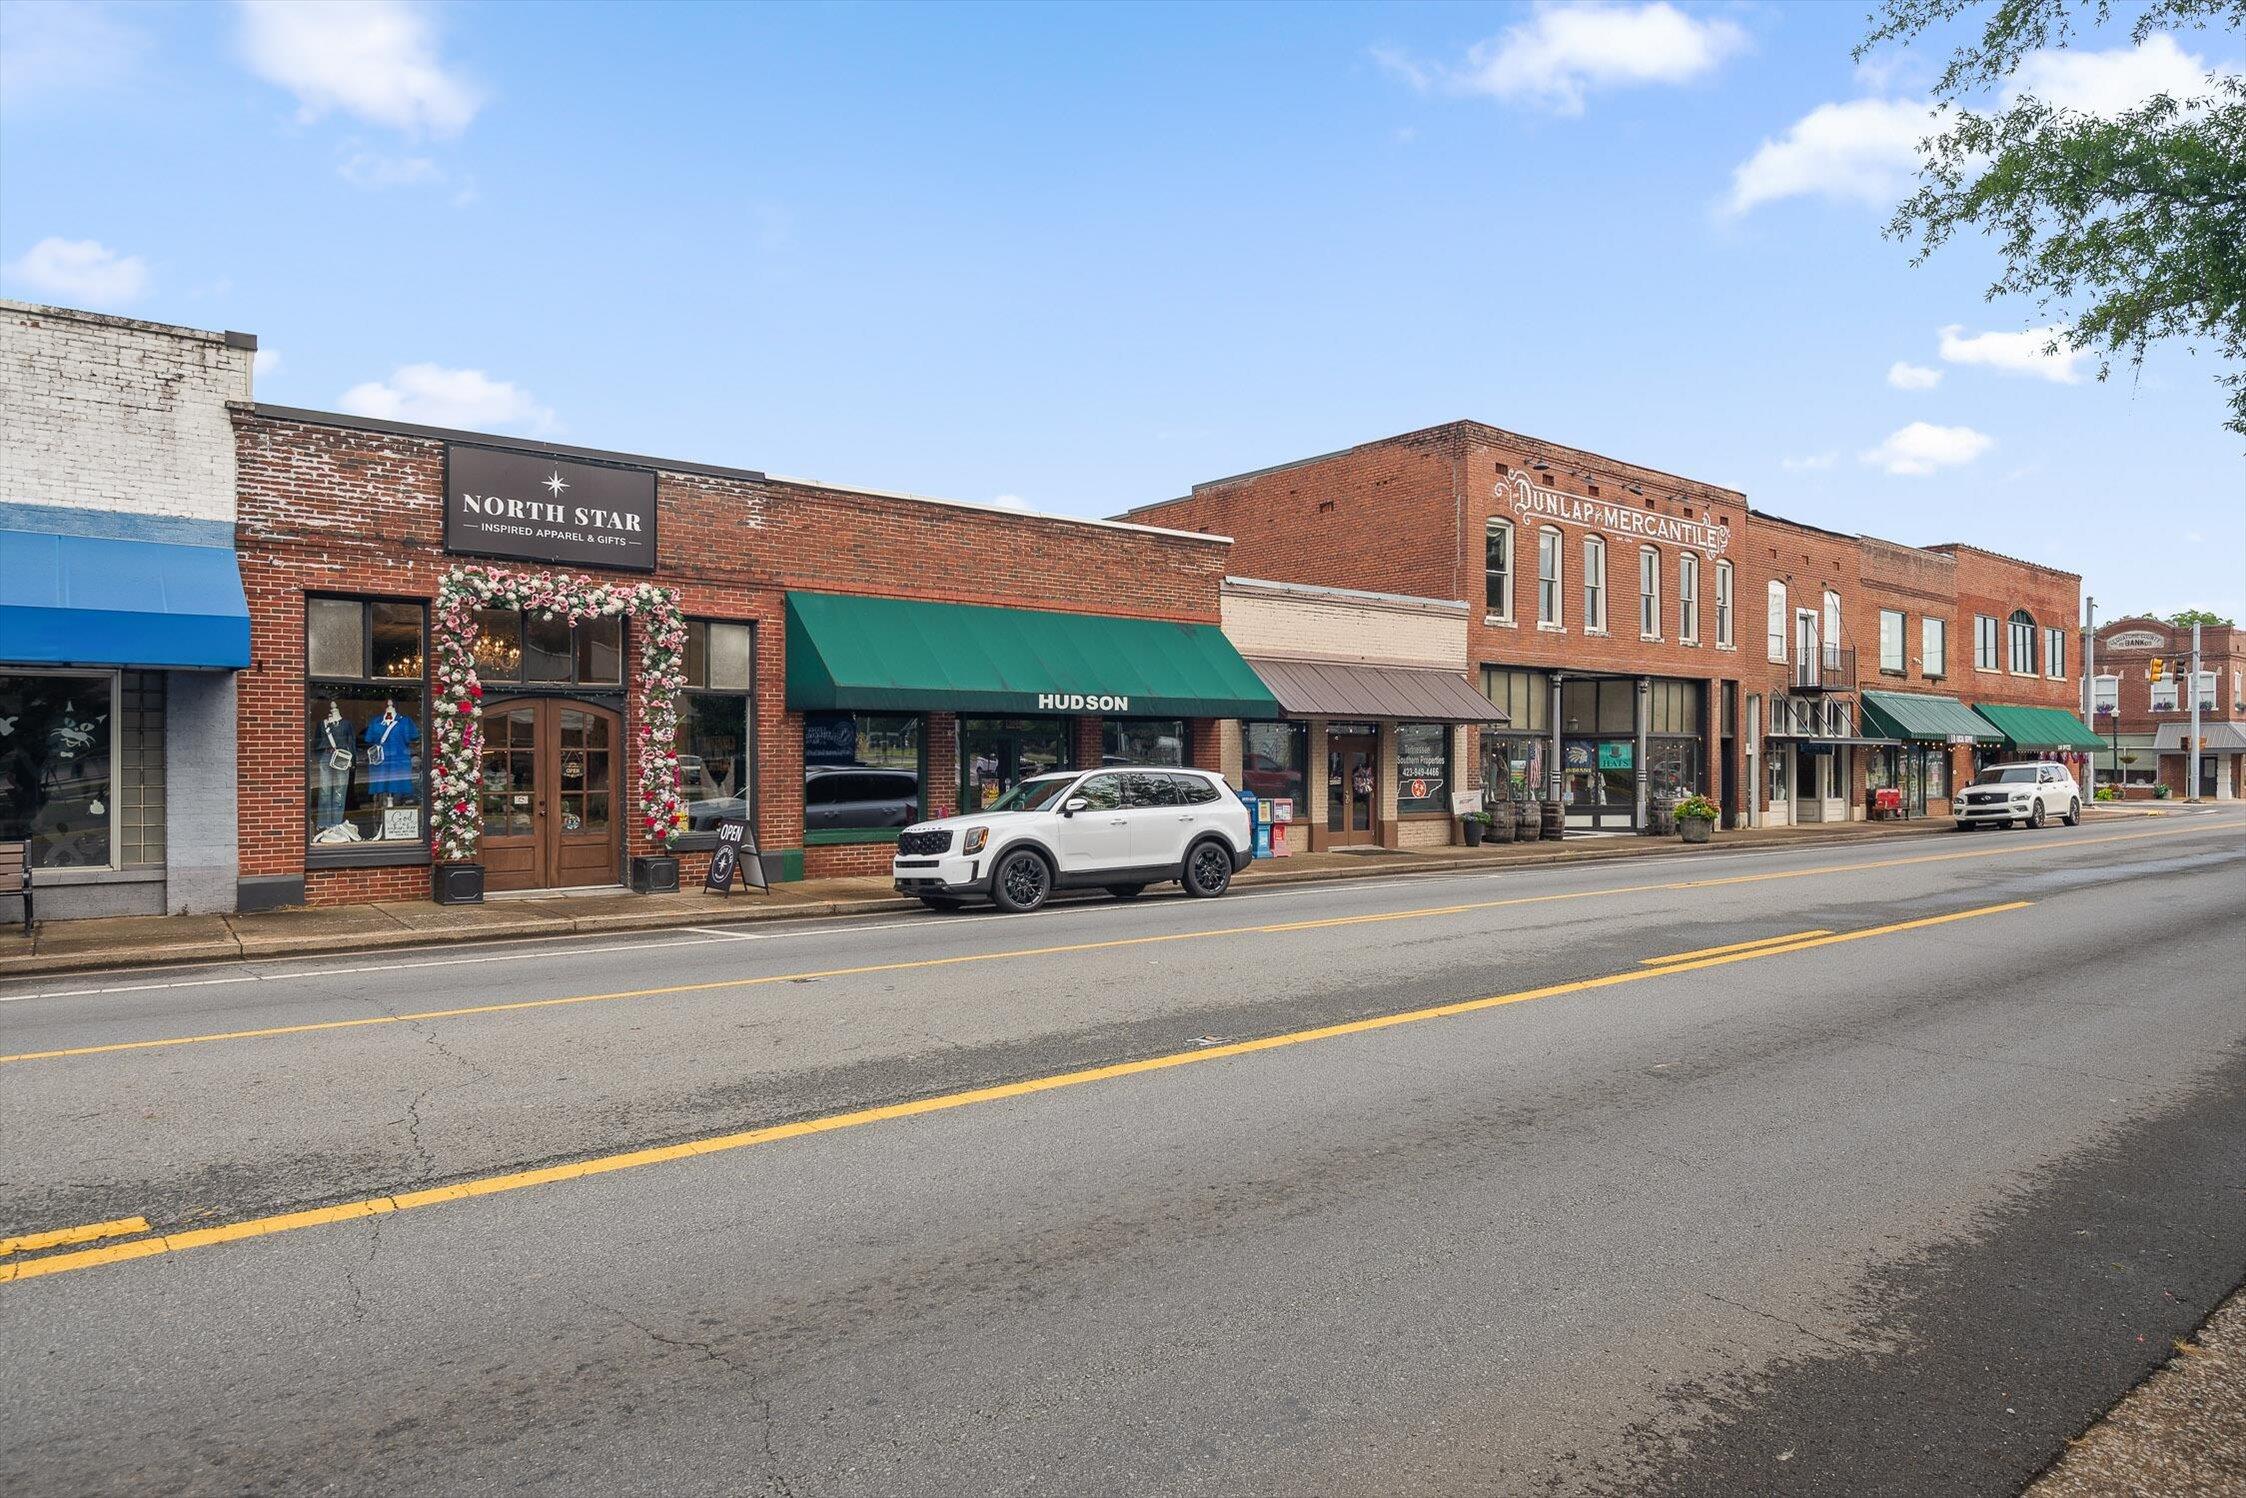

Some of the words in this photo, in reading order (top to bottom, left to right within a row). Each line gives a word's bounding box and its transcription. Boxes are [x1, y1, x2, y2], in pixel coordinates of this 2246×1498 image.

[463, 494, 565, 523] NORTH
[575, 507, 642, 532] STAR
[1514, 479, 1593, 522] DUNLAP
[1604, 506, 1717, 548] MERCANTILE
[481, 522, 533, 536] INSPIRED
[536, 529, 584, 542] APPAREL
[587, 534, 595, 543] &
[597, 536, 626, 546] GIFTS
[1038, 693, 1128, 711] HUDSON
[1421, 755, 1445, 766] Properties
[720, 824, 744, 842] OPEN
